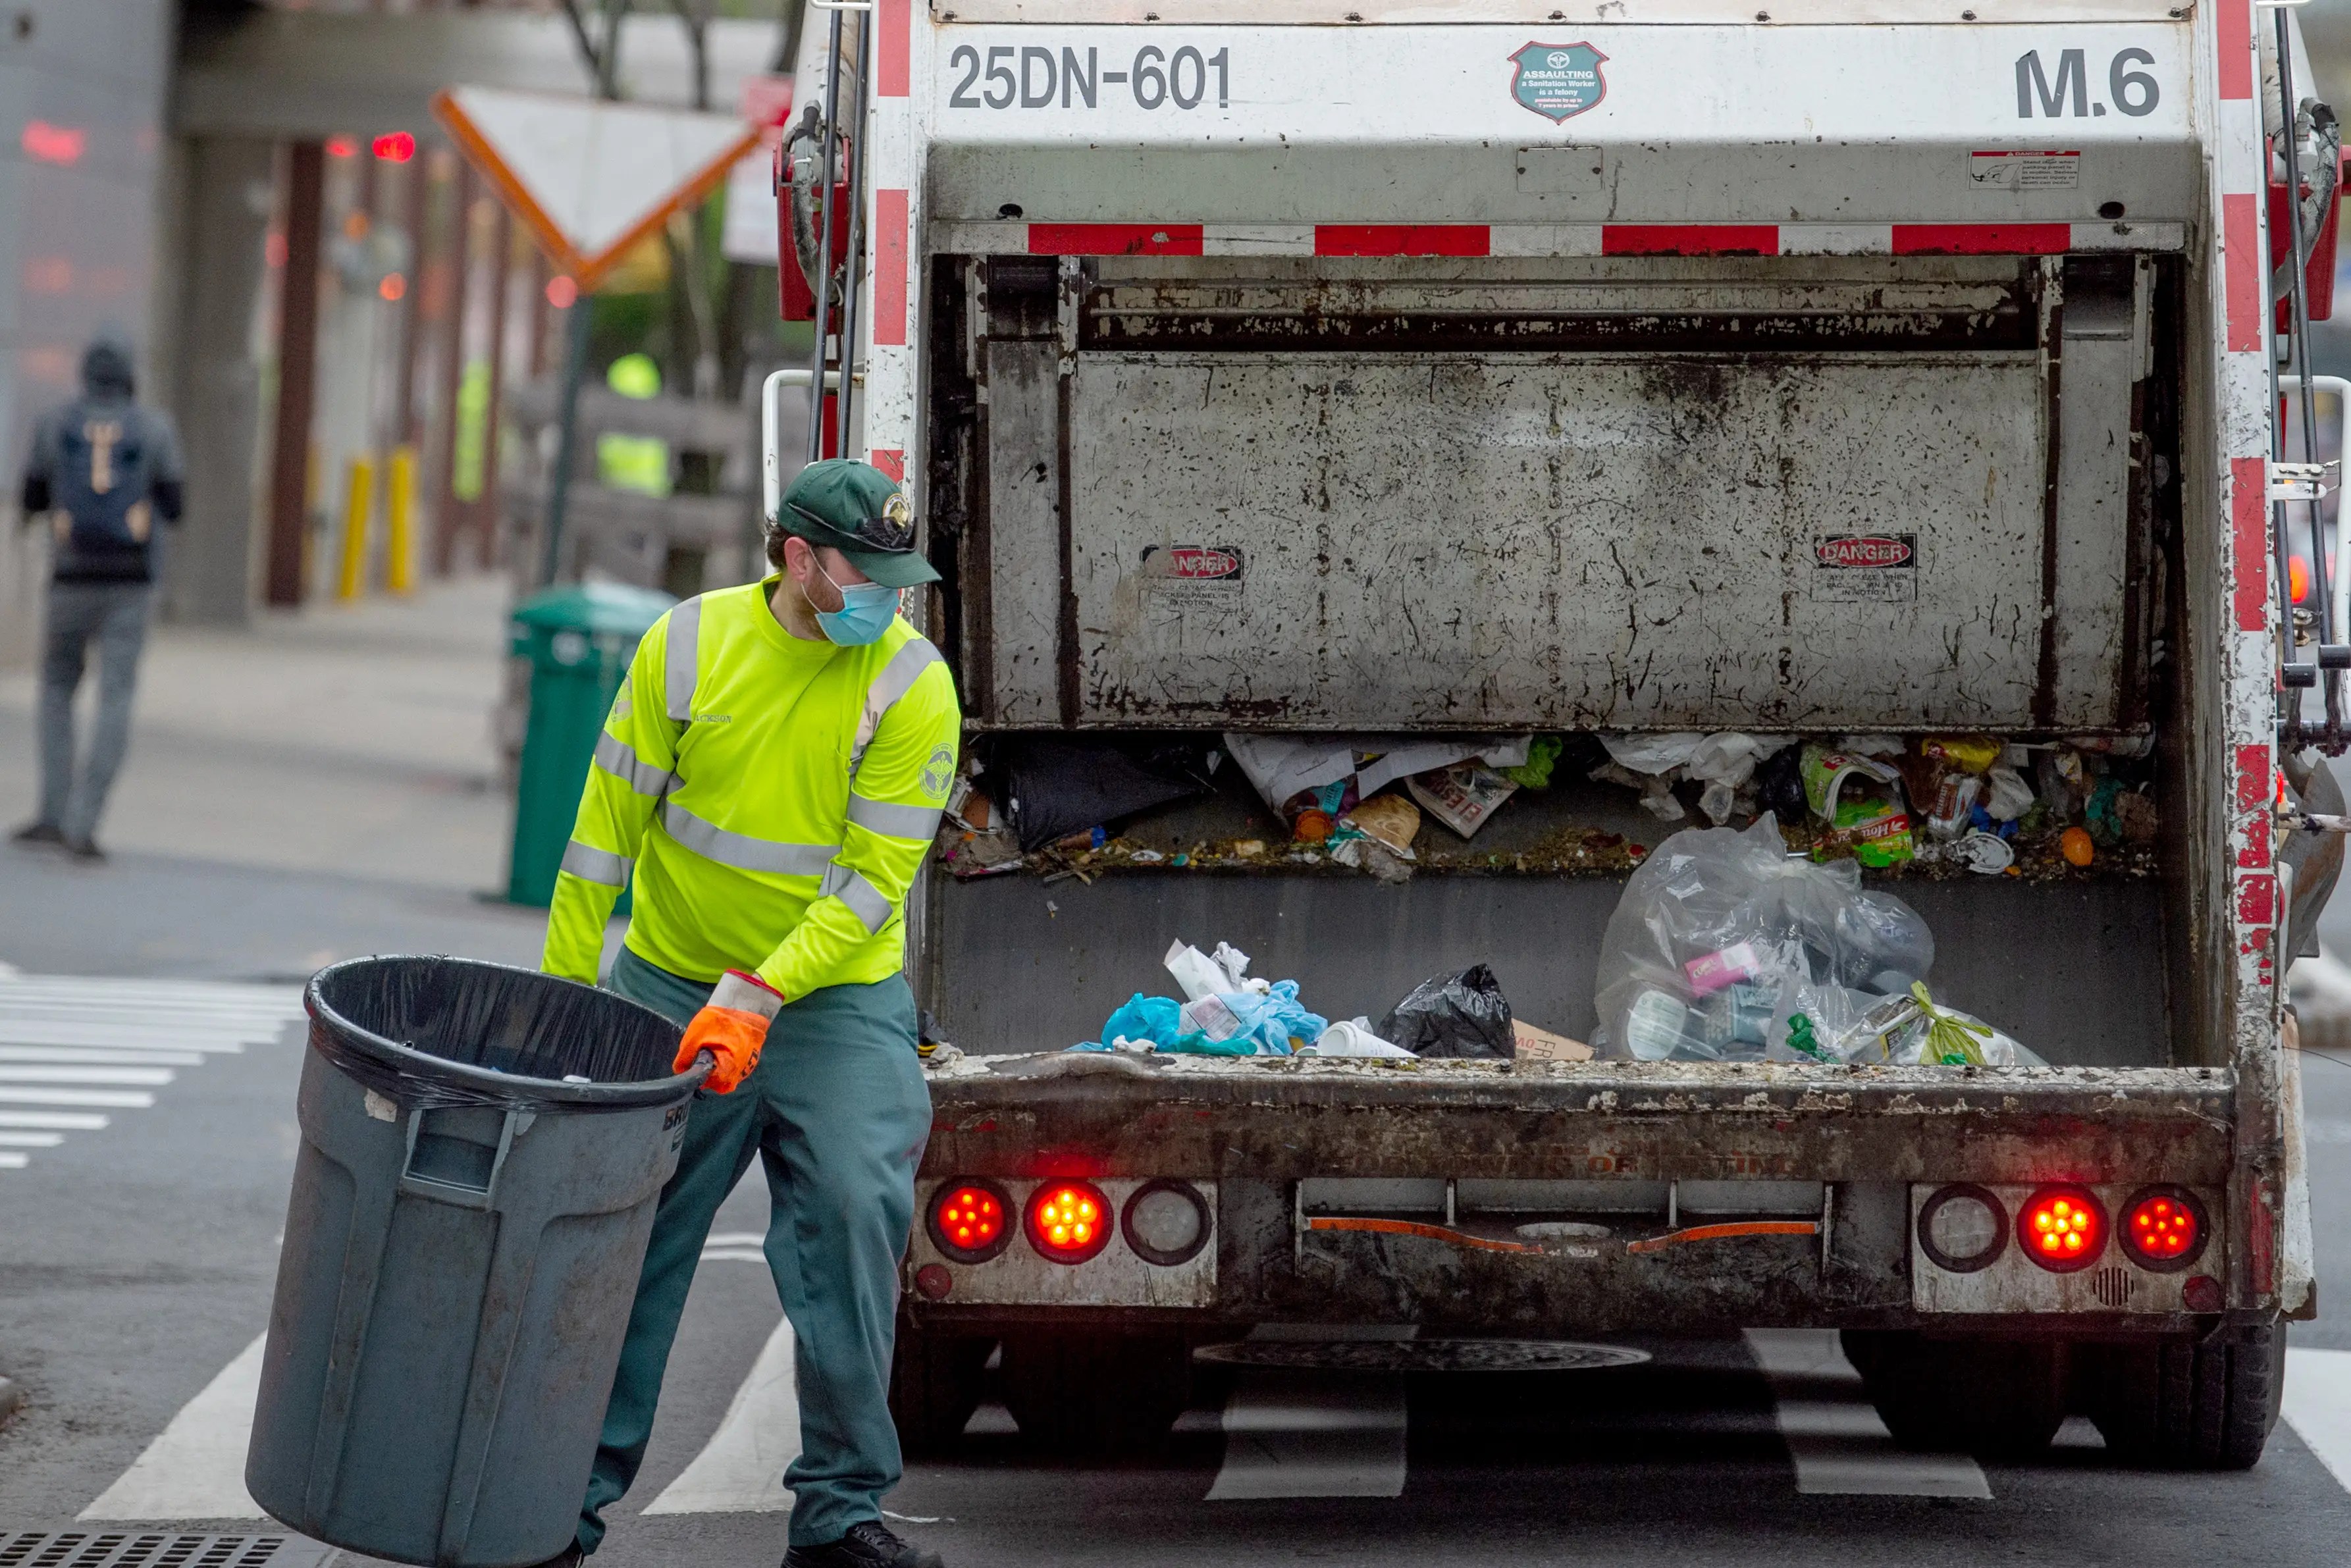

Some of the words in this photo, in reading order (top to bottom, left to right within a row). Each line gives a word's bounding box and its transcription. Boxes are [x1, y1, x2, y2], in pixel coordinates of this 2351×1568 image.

[949, 44, 1228, 110] 25DN-601
[2015, 47, 2161, 118] M.6
[1824, 544, 1903, 562] DANGER
